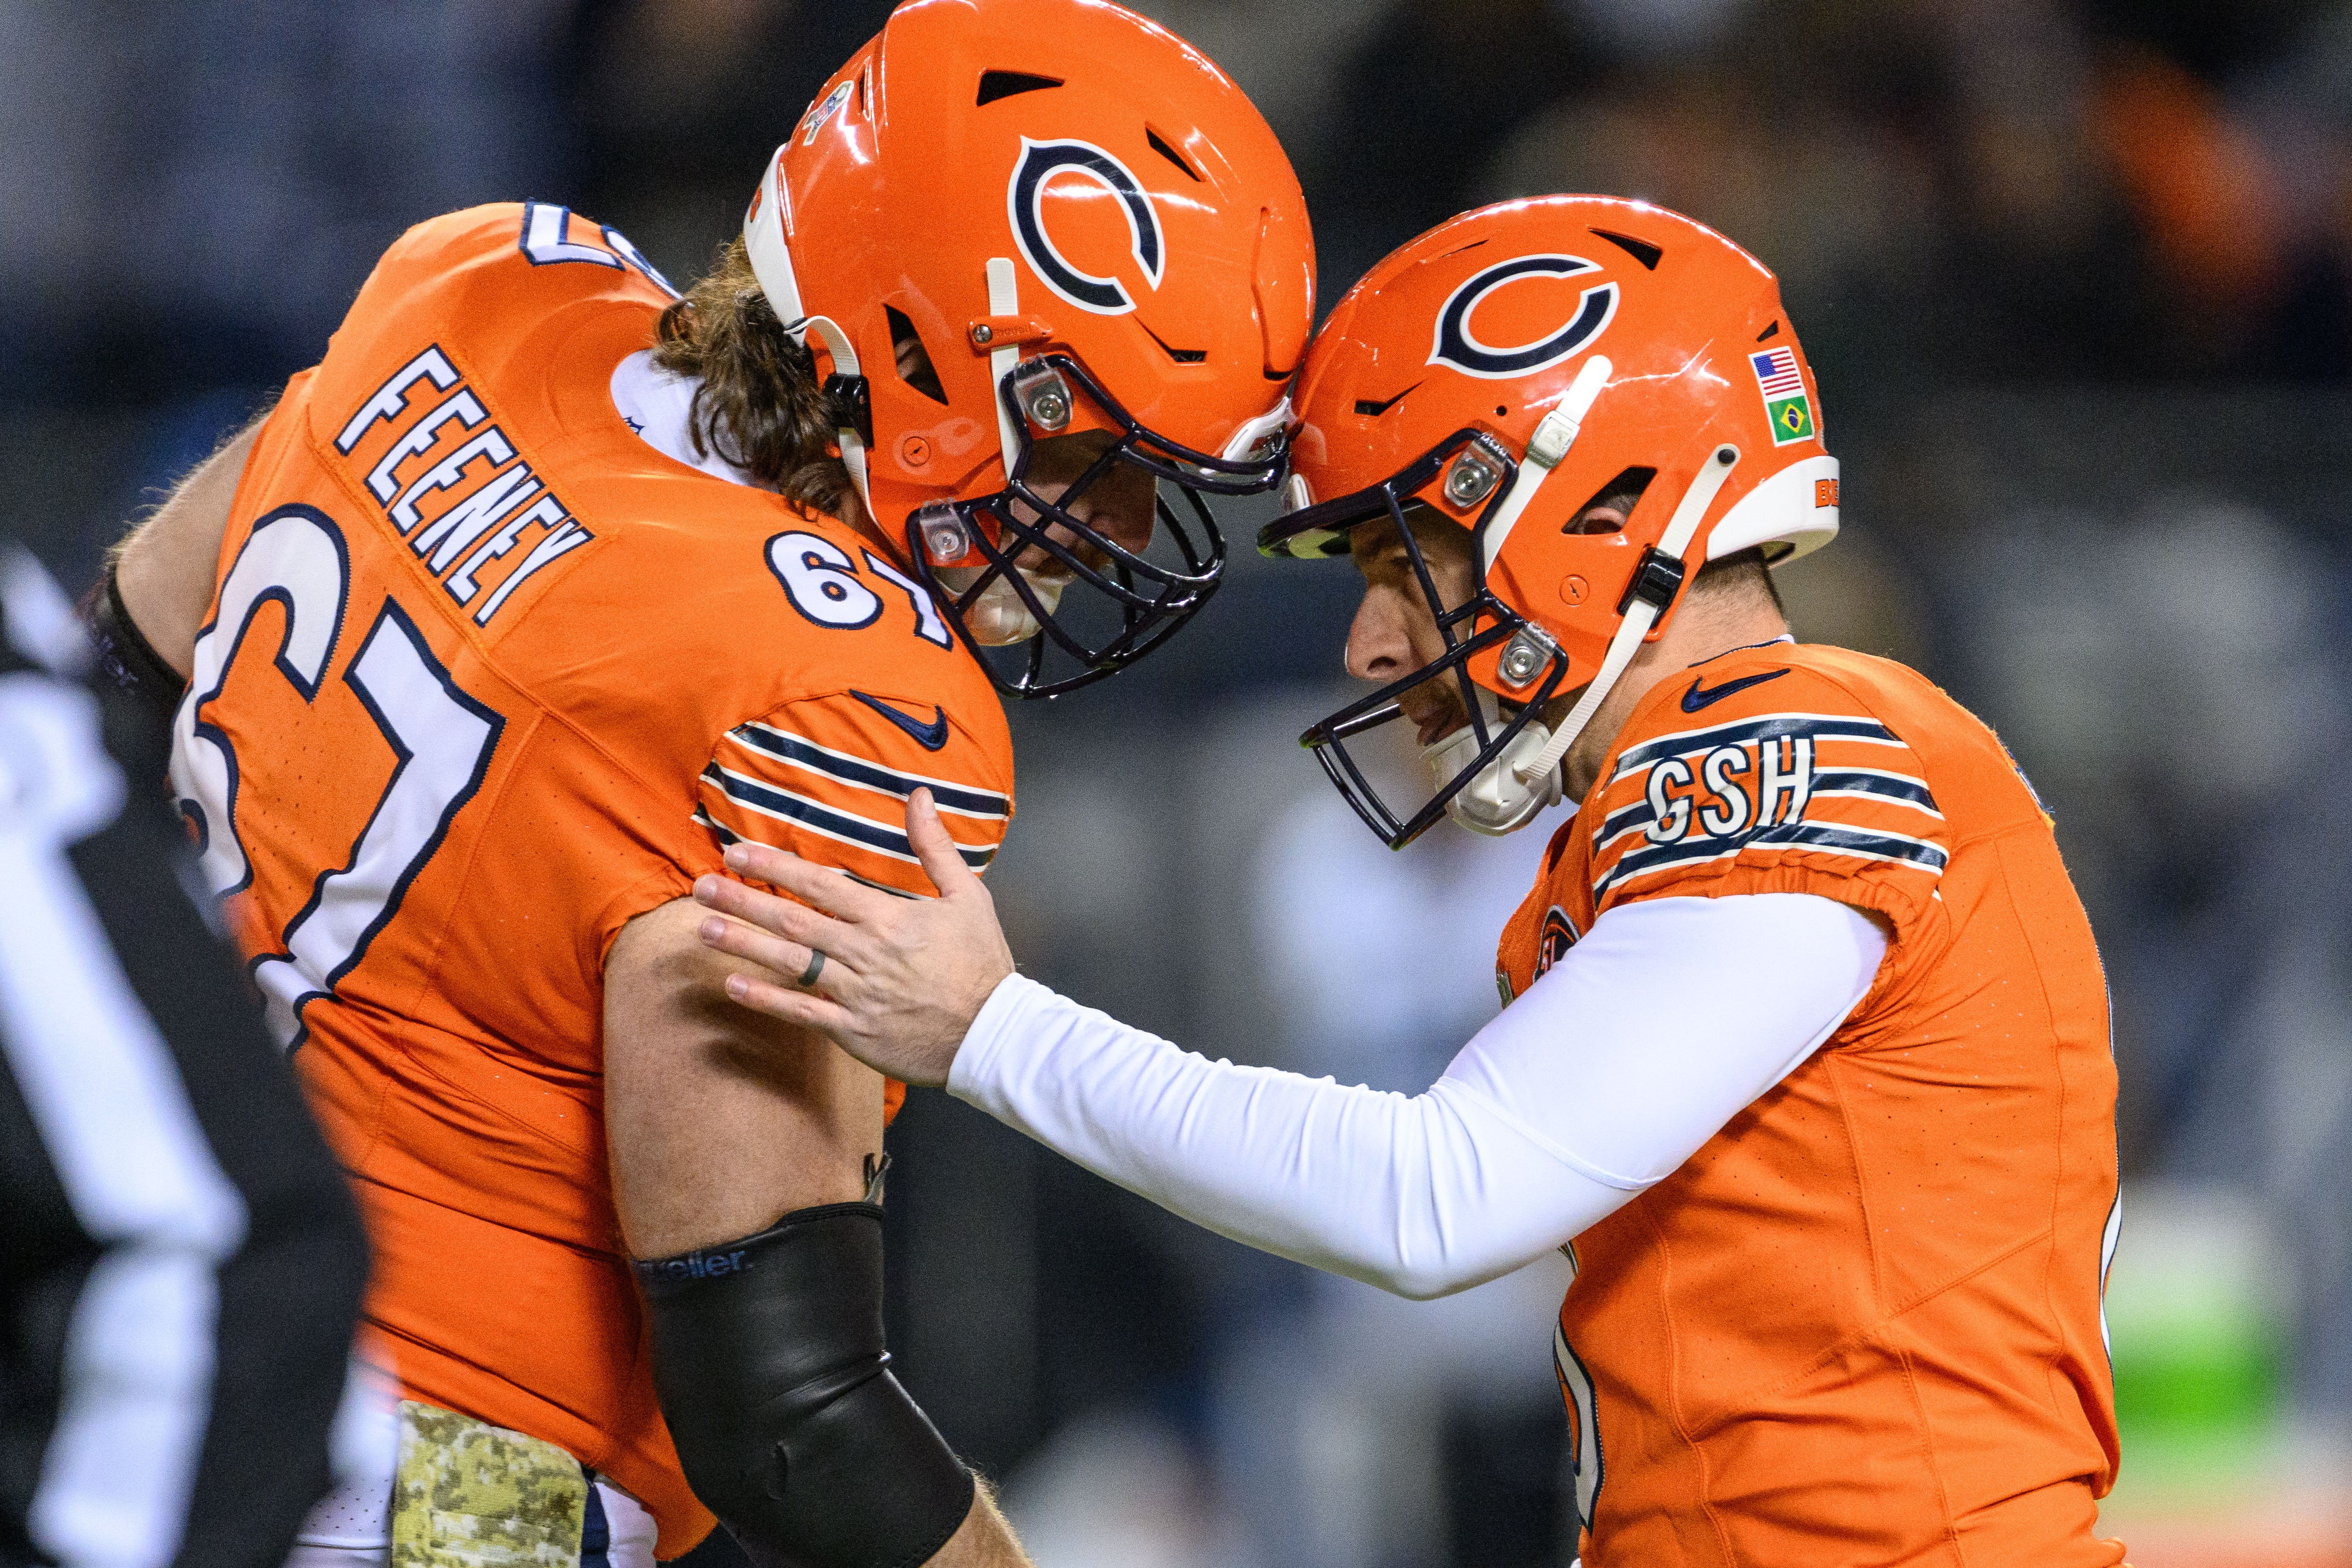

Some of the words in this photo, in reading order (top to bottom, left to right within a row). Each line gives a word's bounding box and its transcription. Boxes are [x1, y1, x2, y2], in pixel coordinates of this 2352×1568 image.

[333, 342, 596, 628] FEENEY
[763, 530, 953, 652] 67
[168, 503, 507, 1052] 67
[1644, 734, 1815, 846] GSH
